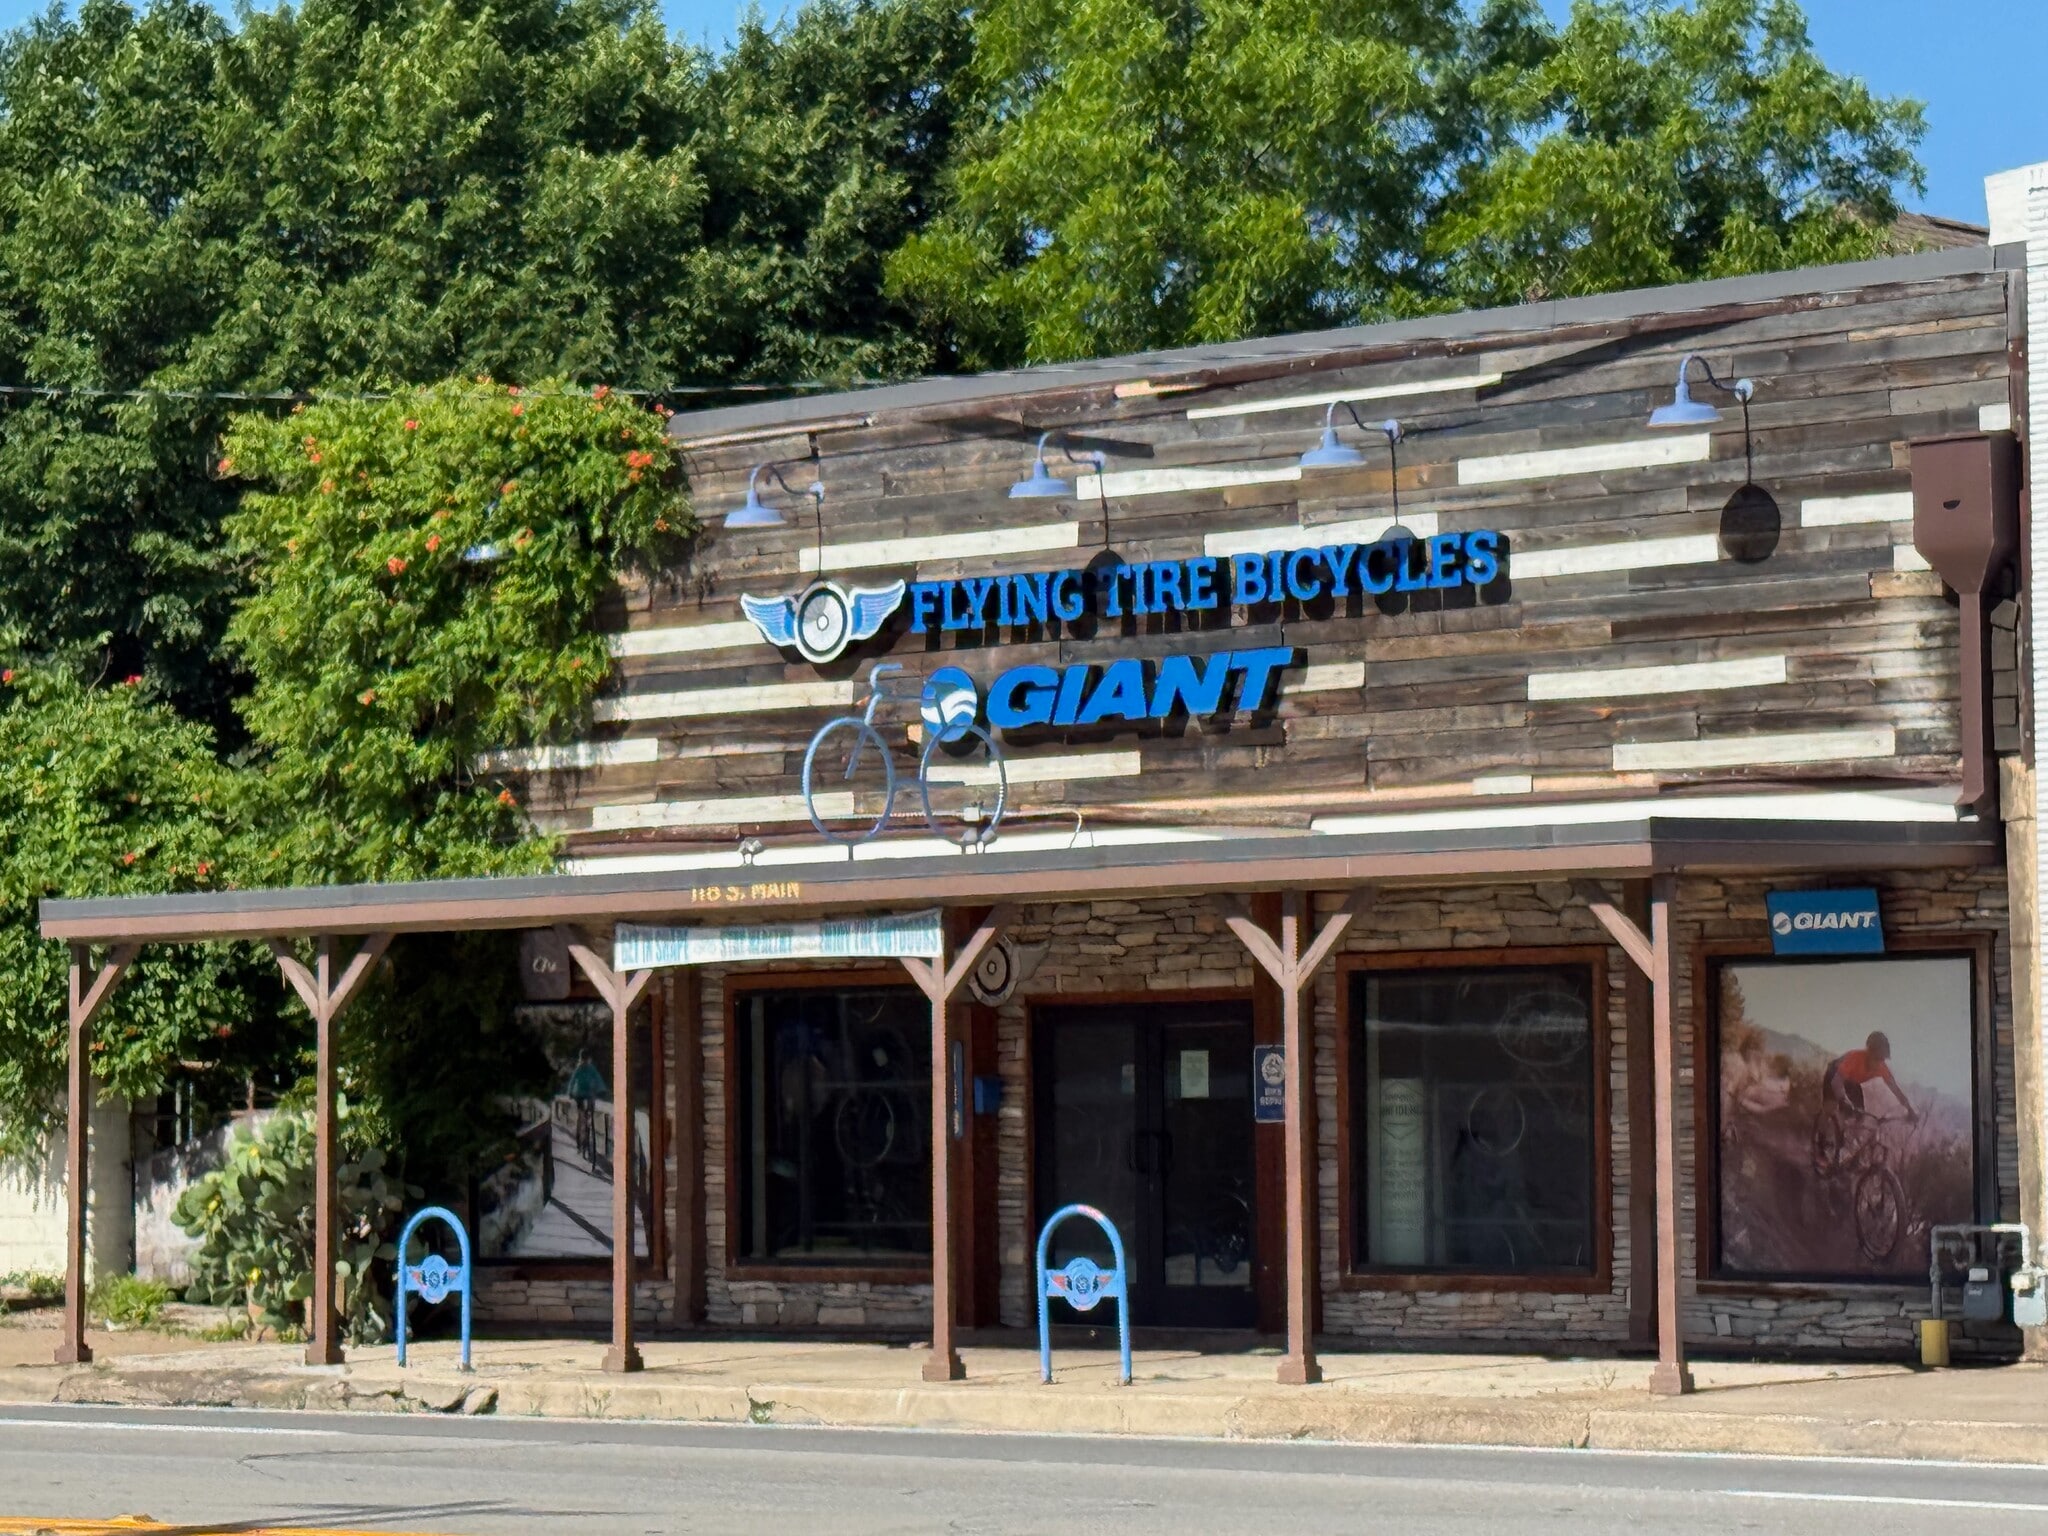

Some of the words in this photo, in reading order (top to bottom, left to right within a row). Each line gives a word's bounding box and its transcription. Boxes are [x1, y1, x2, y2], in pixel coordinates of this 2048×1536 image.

[909, 570, 1084, 634] FLYING
[1100, 557, 1218, 618] TIRE
[1231, 530, 1498, 605] BICYCLES
[987, 646, 1294, 728] GIANT
[751, 881, 800, 900] MAIN
[1793, 911, 1878, 930] GIANT
